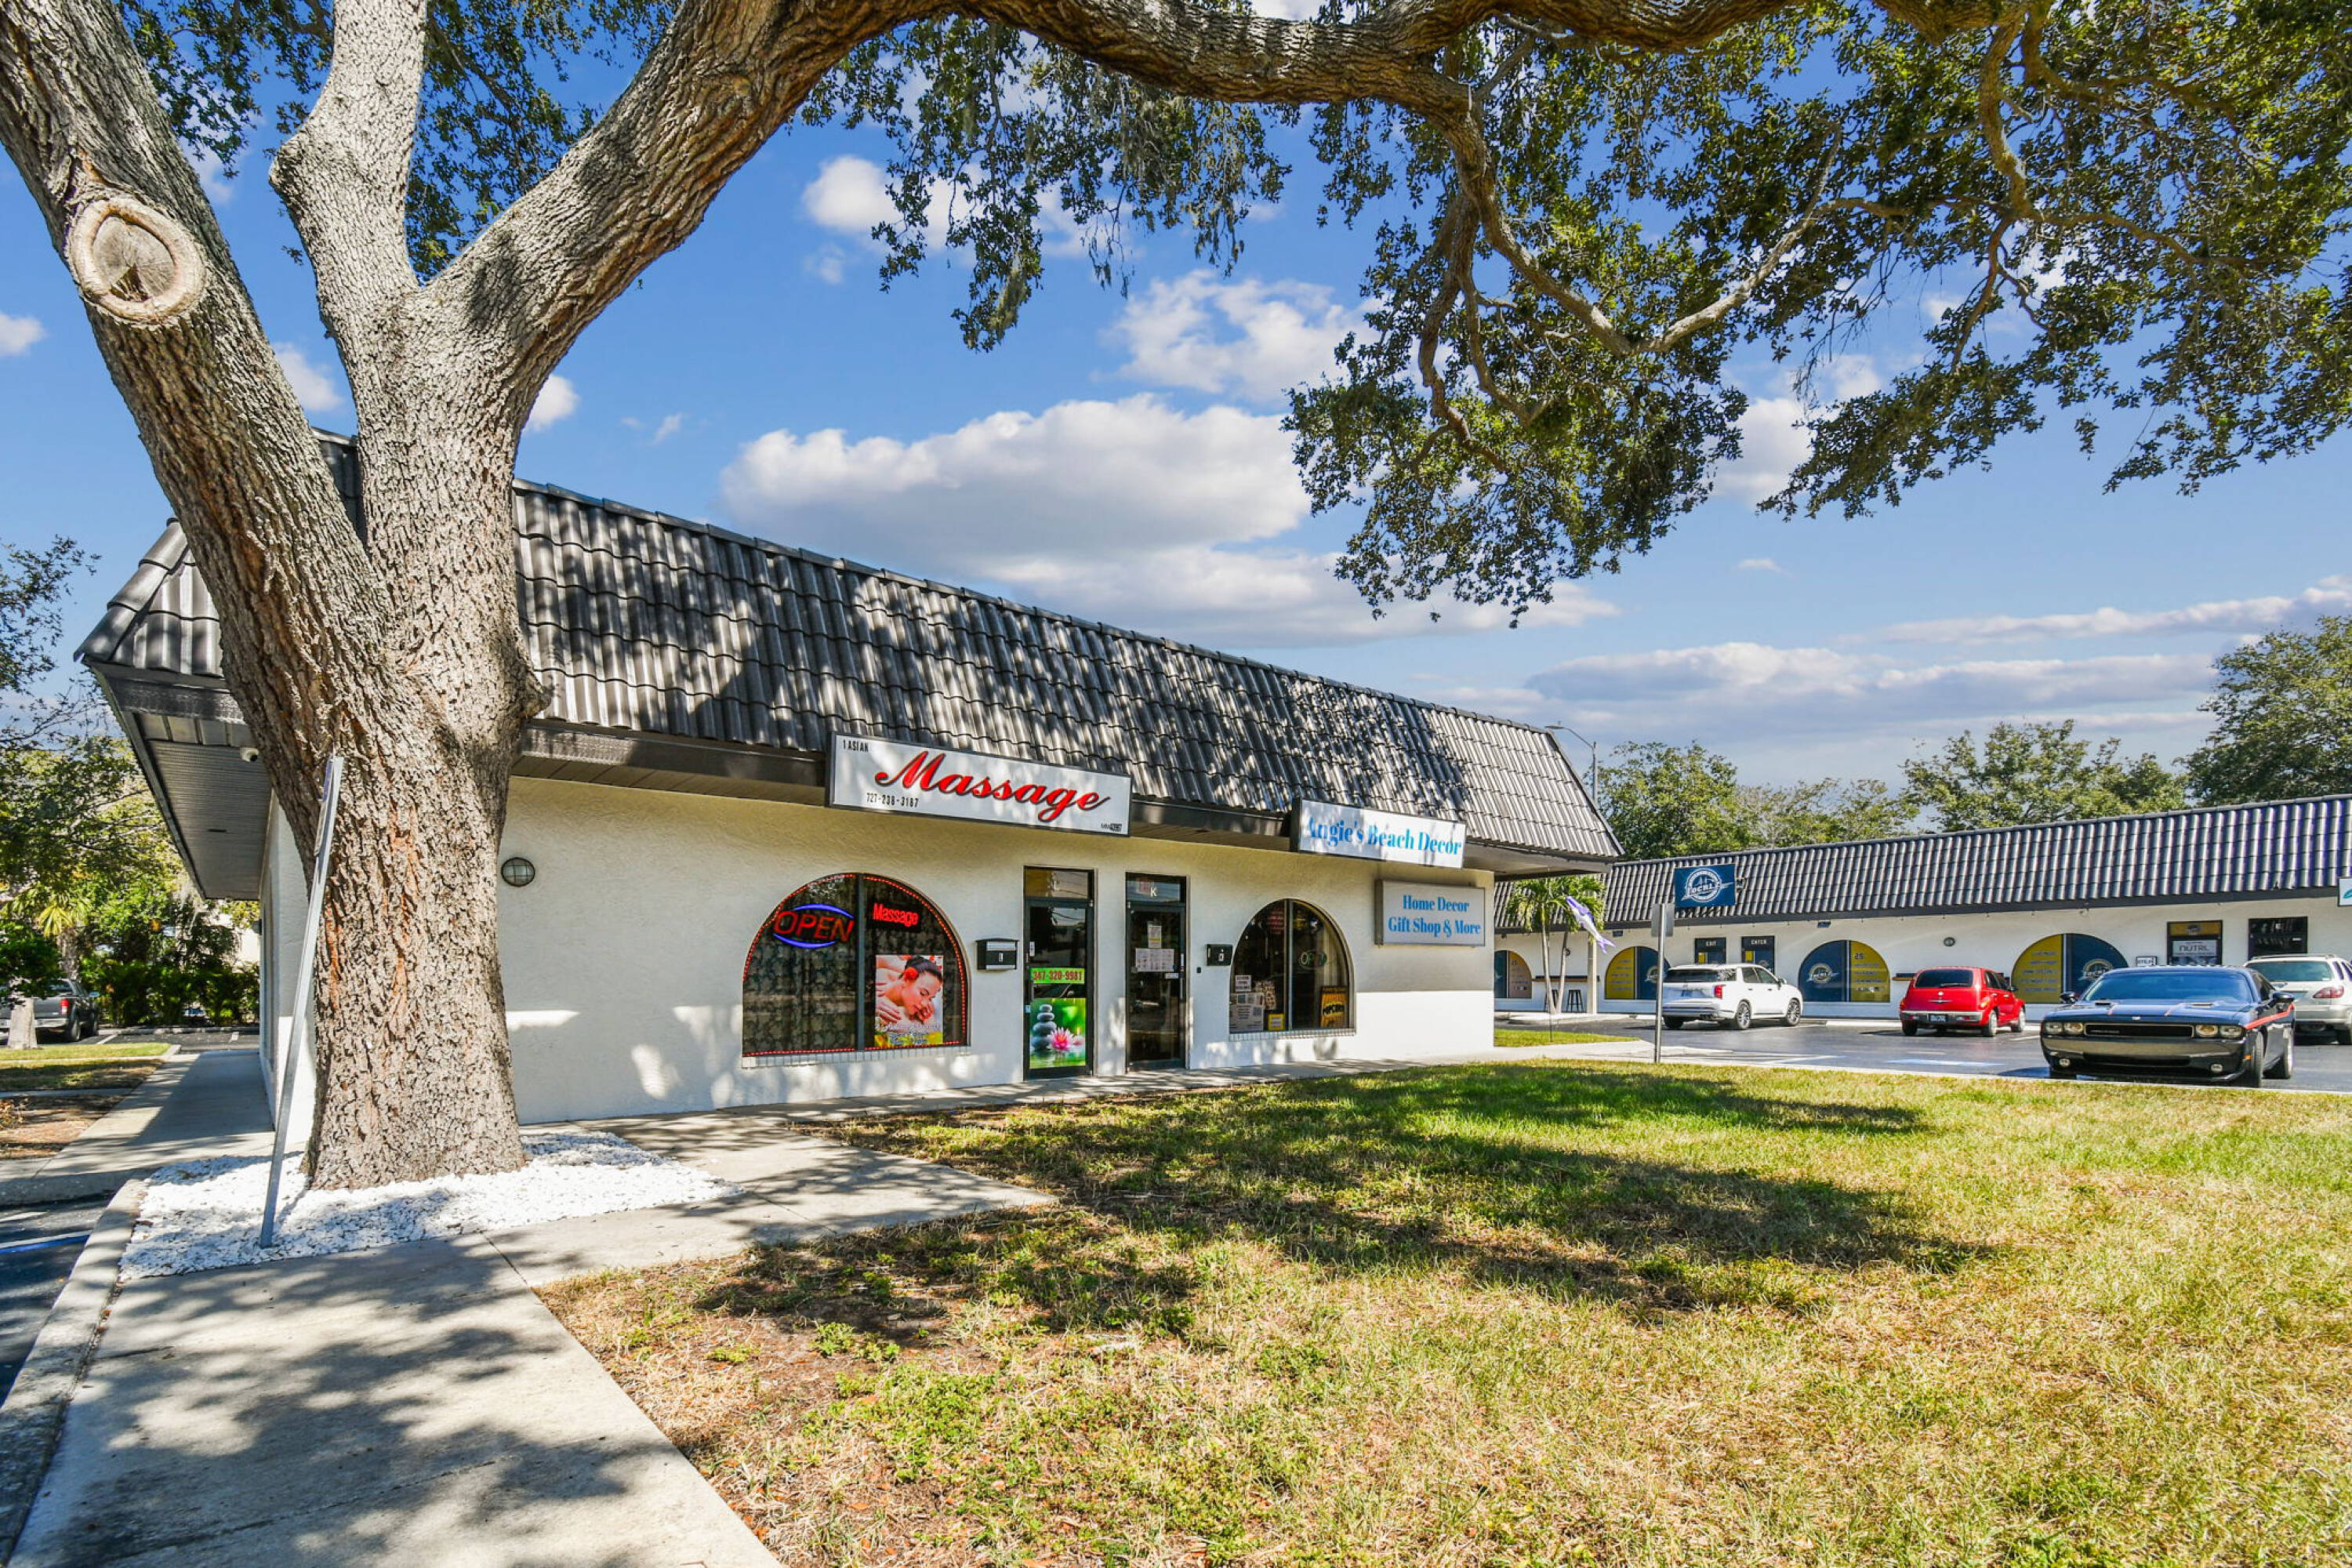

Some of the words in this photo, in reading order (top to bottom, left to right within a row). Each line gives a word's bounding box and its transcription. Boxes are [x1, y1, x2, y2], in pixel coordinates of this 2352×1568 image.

[874, 750, 1110, 822] Massage
[1308, 817, 1363, 847] Angie's
[1367, 826, 1414, 851] Beach
[1417, 832, 1462, 855] Decor
[1150, 886, 1158, 898] K
[1403, 895, 1436, 911] Home
[1437, 897, 1470, 913] Decor
[774, 910, 855, 942] OPEN
[873, 902, 920, 927] Massage
[1388, 917, 1411, 933] Gift
[1413, 917, 1441, 938] Shop
[1443, 919, 1452, 938] &
[1454, 920, 1482, 935] More
